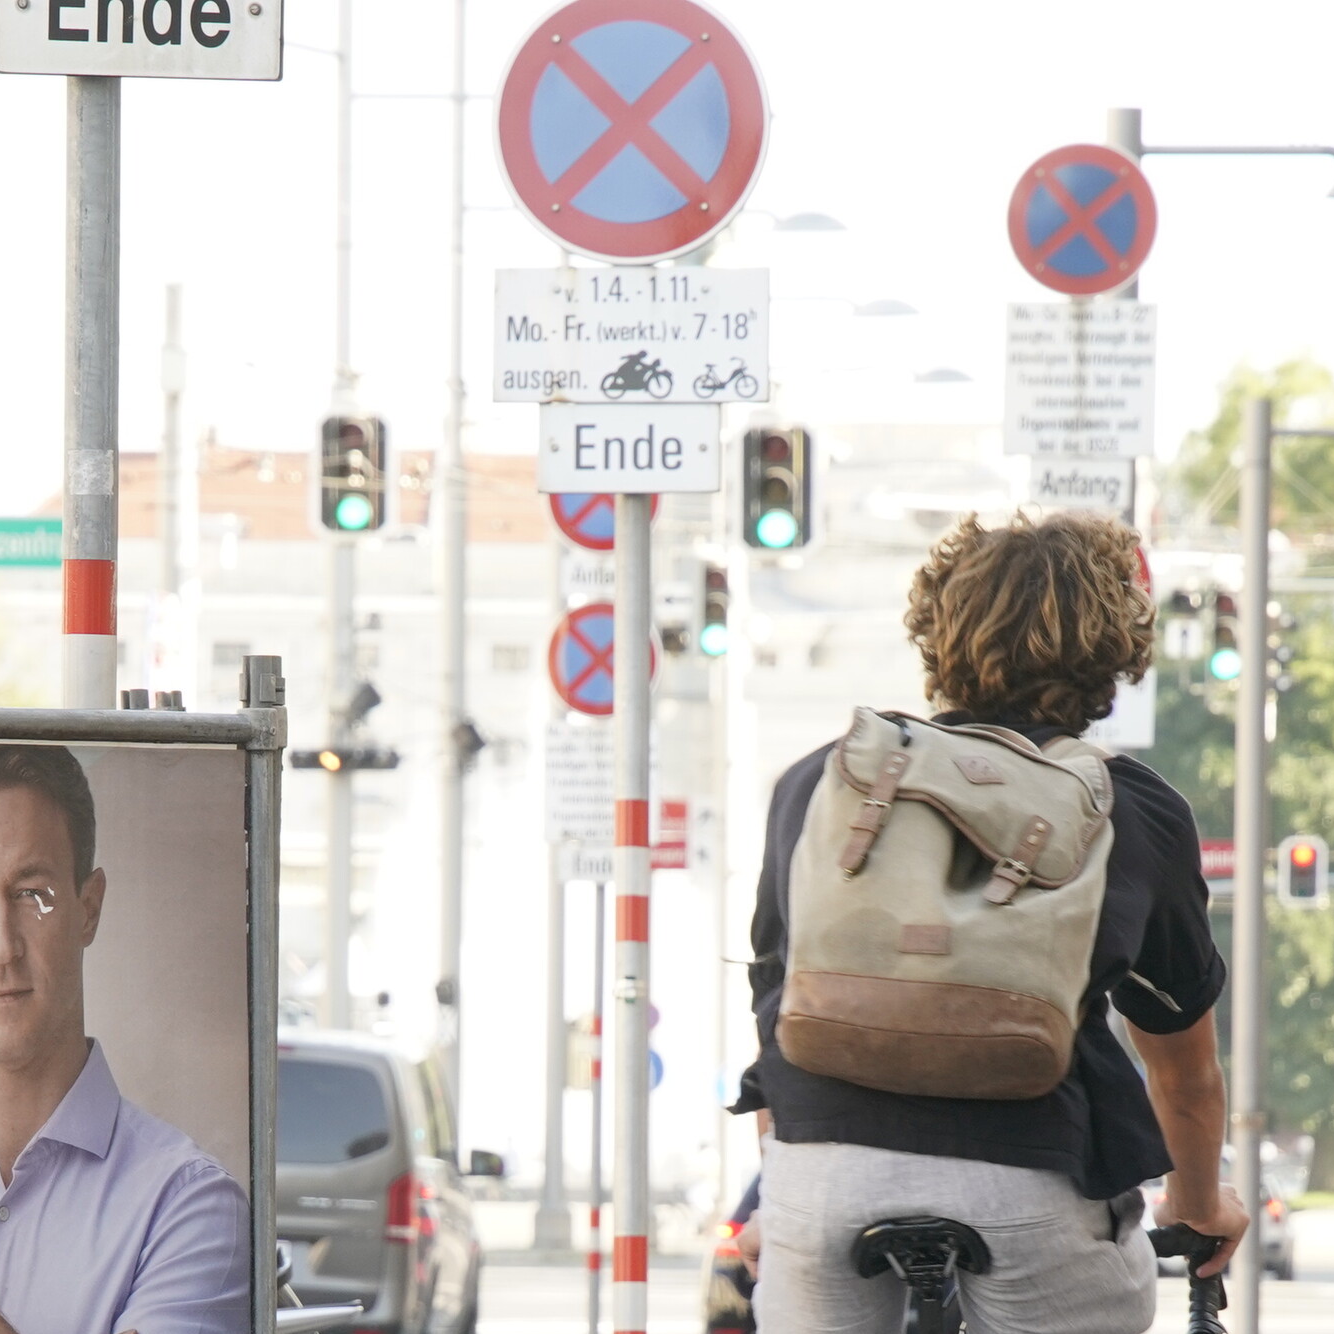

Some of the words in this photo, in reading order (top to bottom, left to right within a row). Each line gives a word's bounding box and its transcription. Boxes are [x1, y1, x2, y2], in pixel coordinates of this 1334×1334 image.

[47, 0, 231, 49] Ende
[503, 369, 588, 396] ausgen.
[575, 424, 683, 471] Ende
